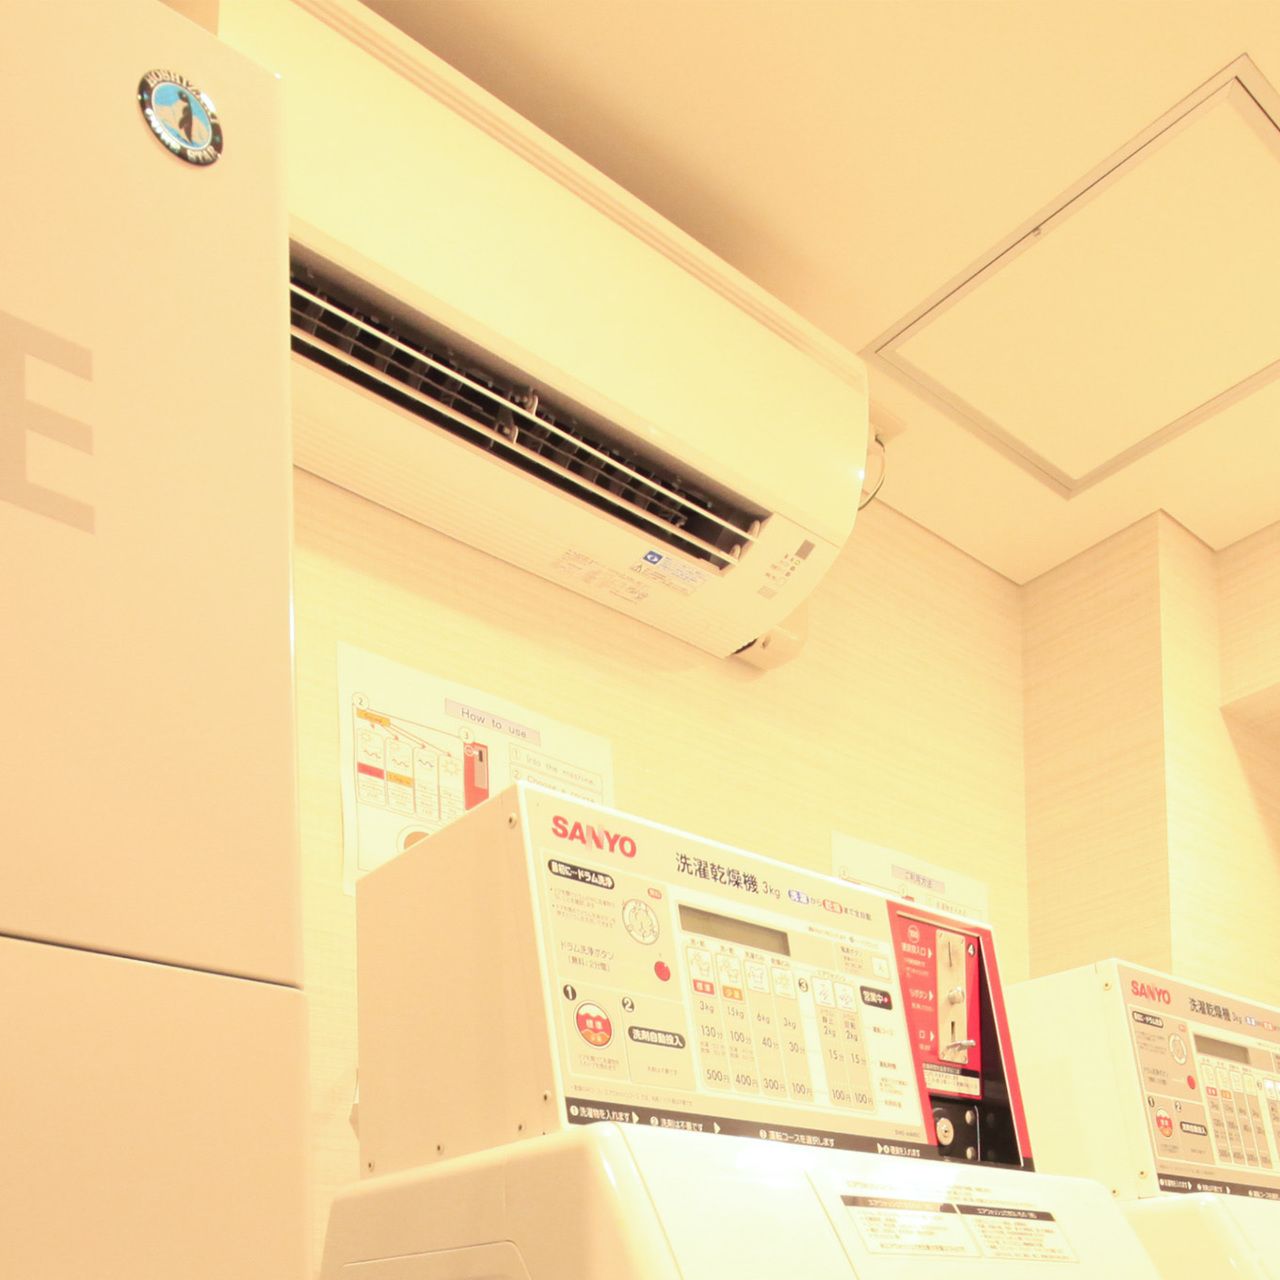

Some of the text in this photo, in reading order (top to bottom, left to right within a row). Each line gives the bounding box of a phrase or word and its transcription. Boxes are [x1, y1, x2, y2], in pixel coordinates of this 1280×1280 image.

[461, 706, 527, 739] How to use
[551, 815, 637, 858] SANYO
[675, 851, 759, 895] 洗濯乾燥機
[762, 879, 781, 901] 3kg
[1131, 980, 1171, 1005] SANYO
[706, 1068, 731, 1083] 500円
[735, 1073, 760, 1088] 400円
[763, 1076, 787, 1092] 300円
